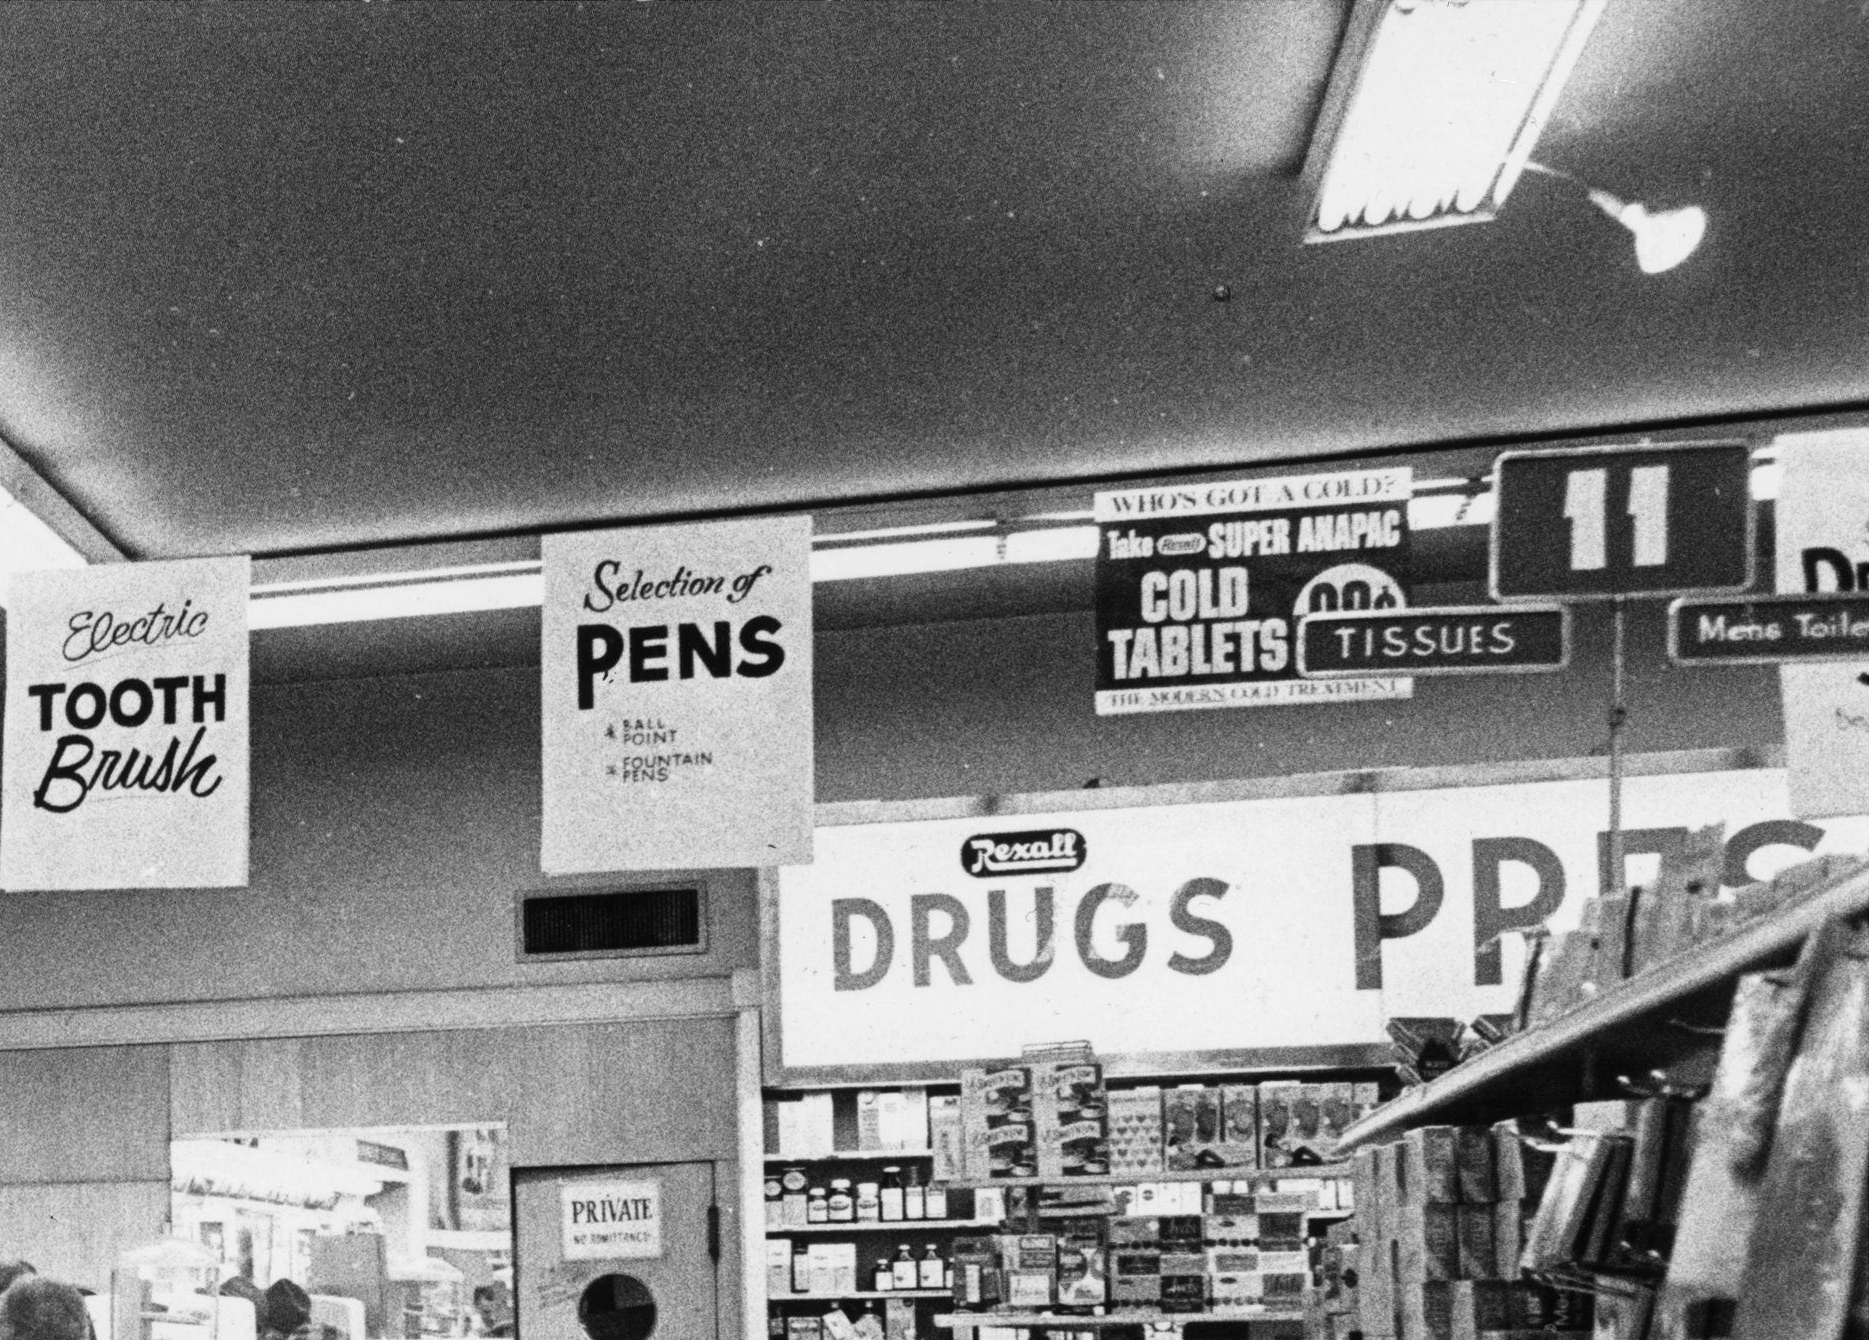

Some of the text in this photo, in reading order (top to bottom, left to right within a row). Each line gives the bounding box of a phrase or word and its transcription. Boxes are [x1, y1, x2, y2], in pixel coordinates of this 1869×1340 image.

[1111, 474, 1397, 517] WHO'S GOT A COLD?
[1562, 465, 1669, 570] 11
[1107, 528, 1154, 560] Take
[1207, 517, 1291, 560] SUPER
[1297, 510, 1401, 553] ANAPAC
[584, 560, 773, 613] Selection of
[1140, 566, 1249, 624] COLD
[62, 600, 210, 661] Electric
[1108, 619, 1289, 680] TABLETS
[1335, 622, 1515, 658] TISSUES
[1699, 614, 1782, 644] Mens
[577, 614, 786, 711] PENS
[28, 673, 227, 732] TOOTH
[622, 718, 666, 732] BALL
[622, 729, 677, 746] POINT
[622, 752, 713, 771] FOUNTAIN
[33, 725, 224, 814] Brush
[622, 767, 669, 783] PENS
[970, 831, 1078, 873] Rexall
[831, 876, 1234, 992] DRUGS
[571, 1198, 653, 1224] PRIVATE
